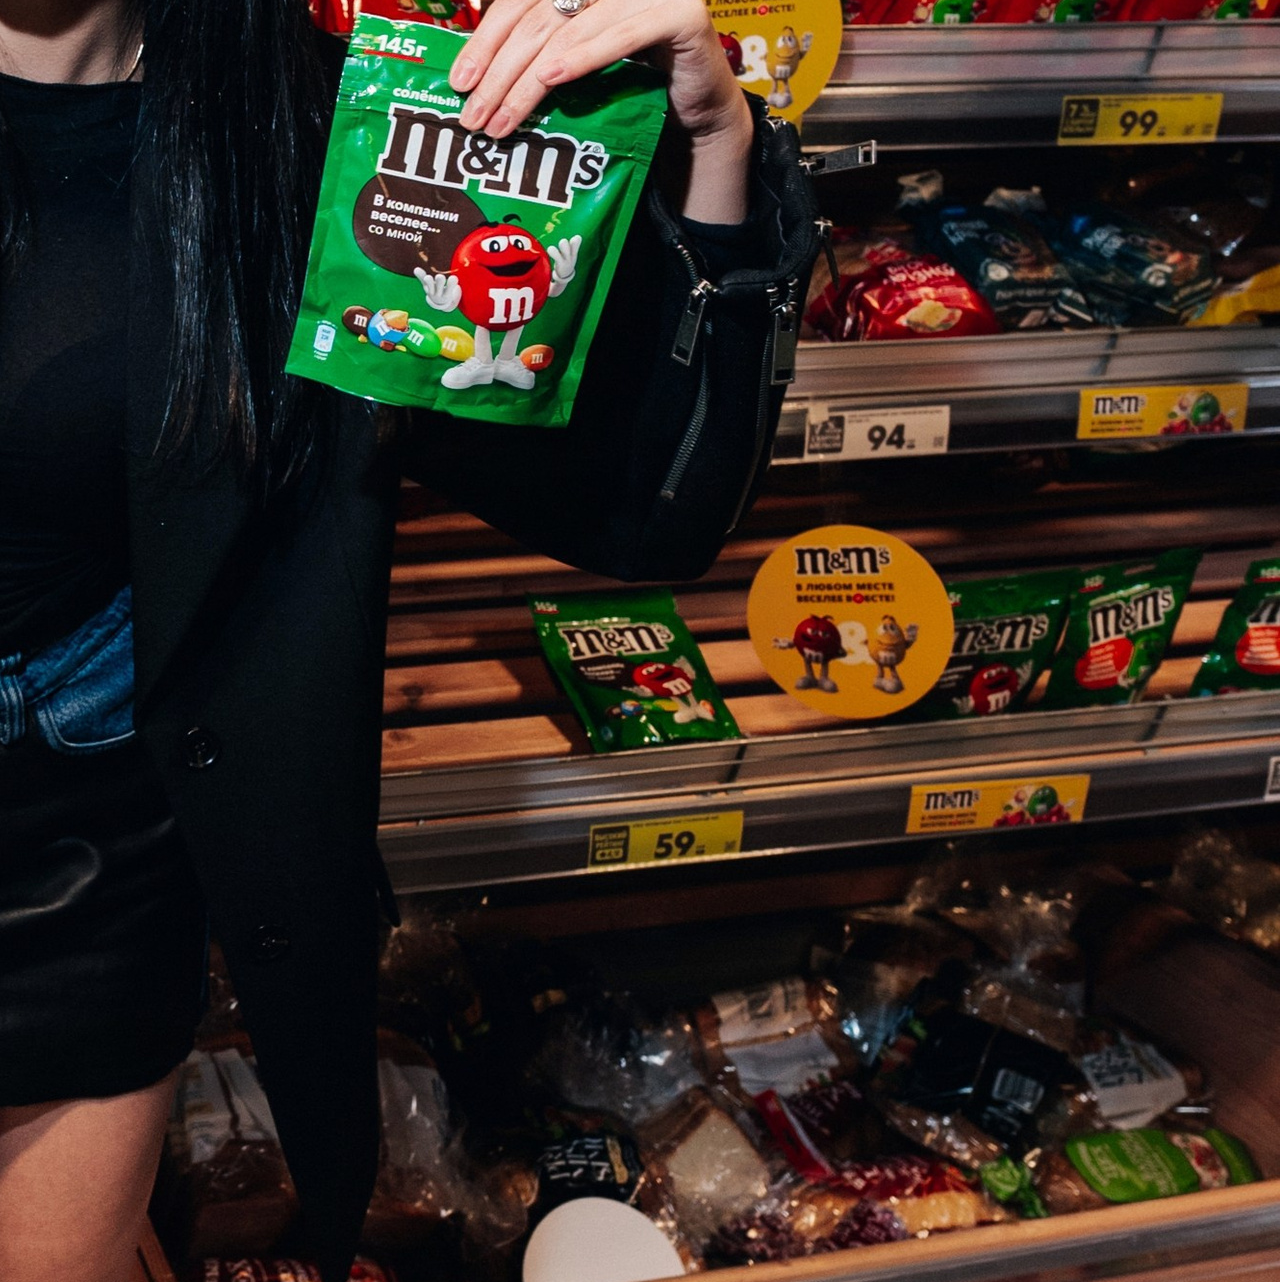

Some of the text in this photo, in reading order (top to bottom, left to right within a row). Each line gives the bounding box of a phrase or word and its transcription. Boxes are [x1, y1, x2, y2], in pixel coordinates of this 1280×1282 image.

[710, 7, 749, 19] ЕСЕЛЕЕ
[378, 34, 429, 59] 145г
[392, 86, 461, 109] солёный
[1120, 108, 1159, 138] 99
[376, 101, 611, 210] m&m's
[369, 210, 442, 234] веселее...
[373, 193, 461, 223] В компании
[368, 223, 423, 245] со мной
[487, 285, 536, 325] m
[867, 423, 906, 451] 94
[793, 545, 894, 576] m&m's
[795, 582, 894, 592] В ЛЮБОМ МЕСТЕ
[796, 594, 843, 603] ВЕСЕЛЕЕ
[1087, 585, 1176, 644] m&m's
[557, 621, 676, 661] m&m's
[654, 831, 696, 860] 59
